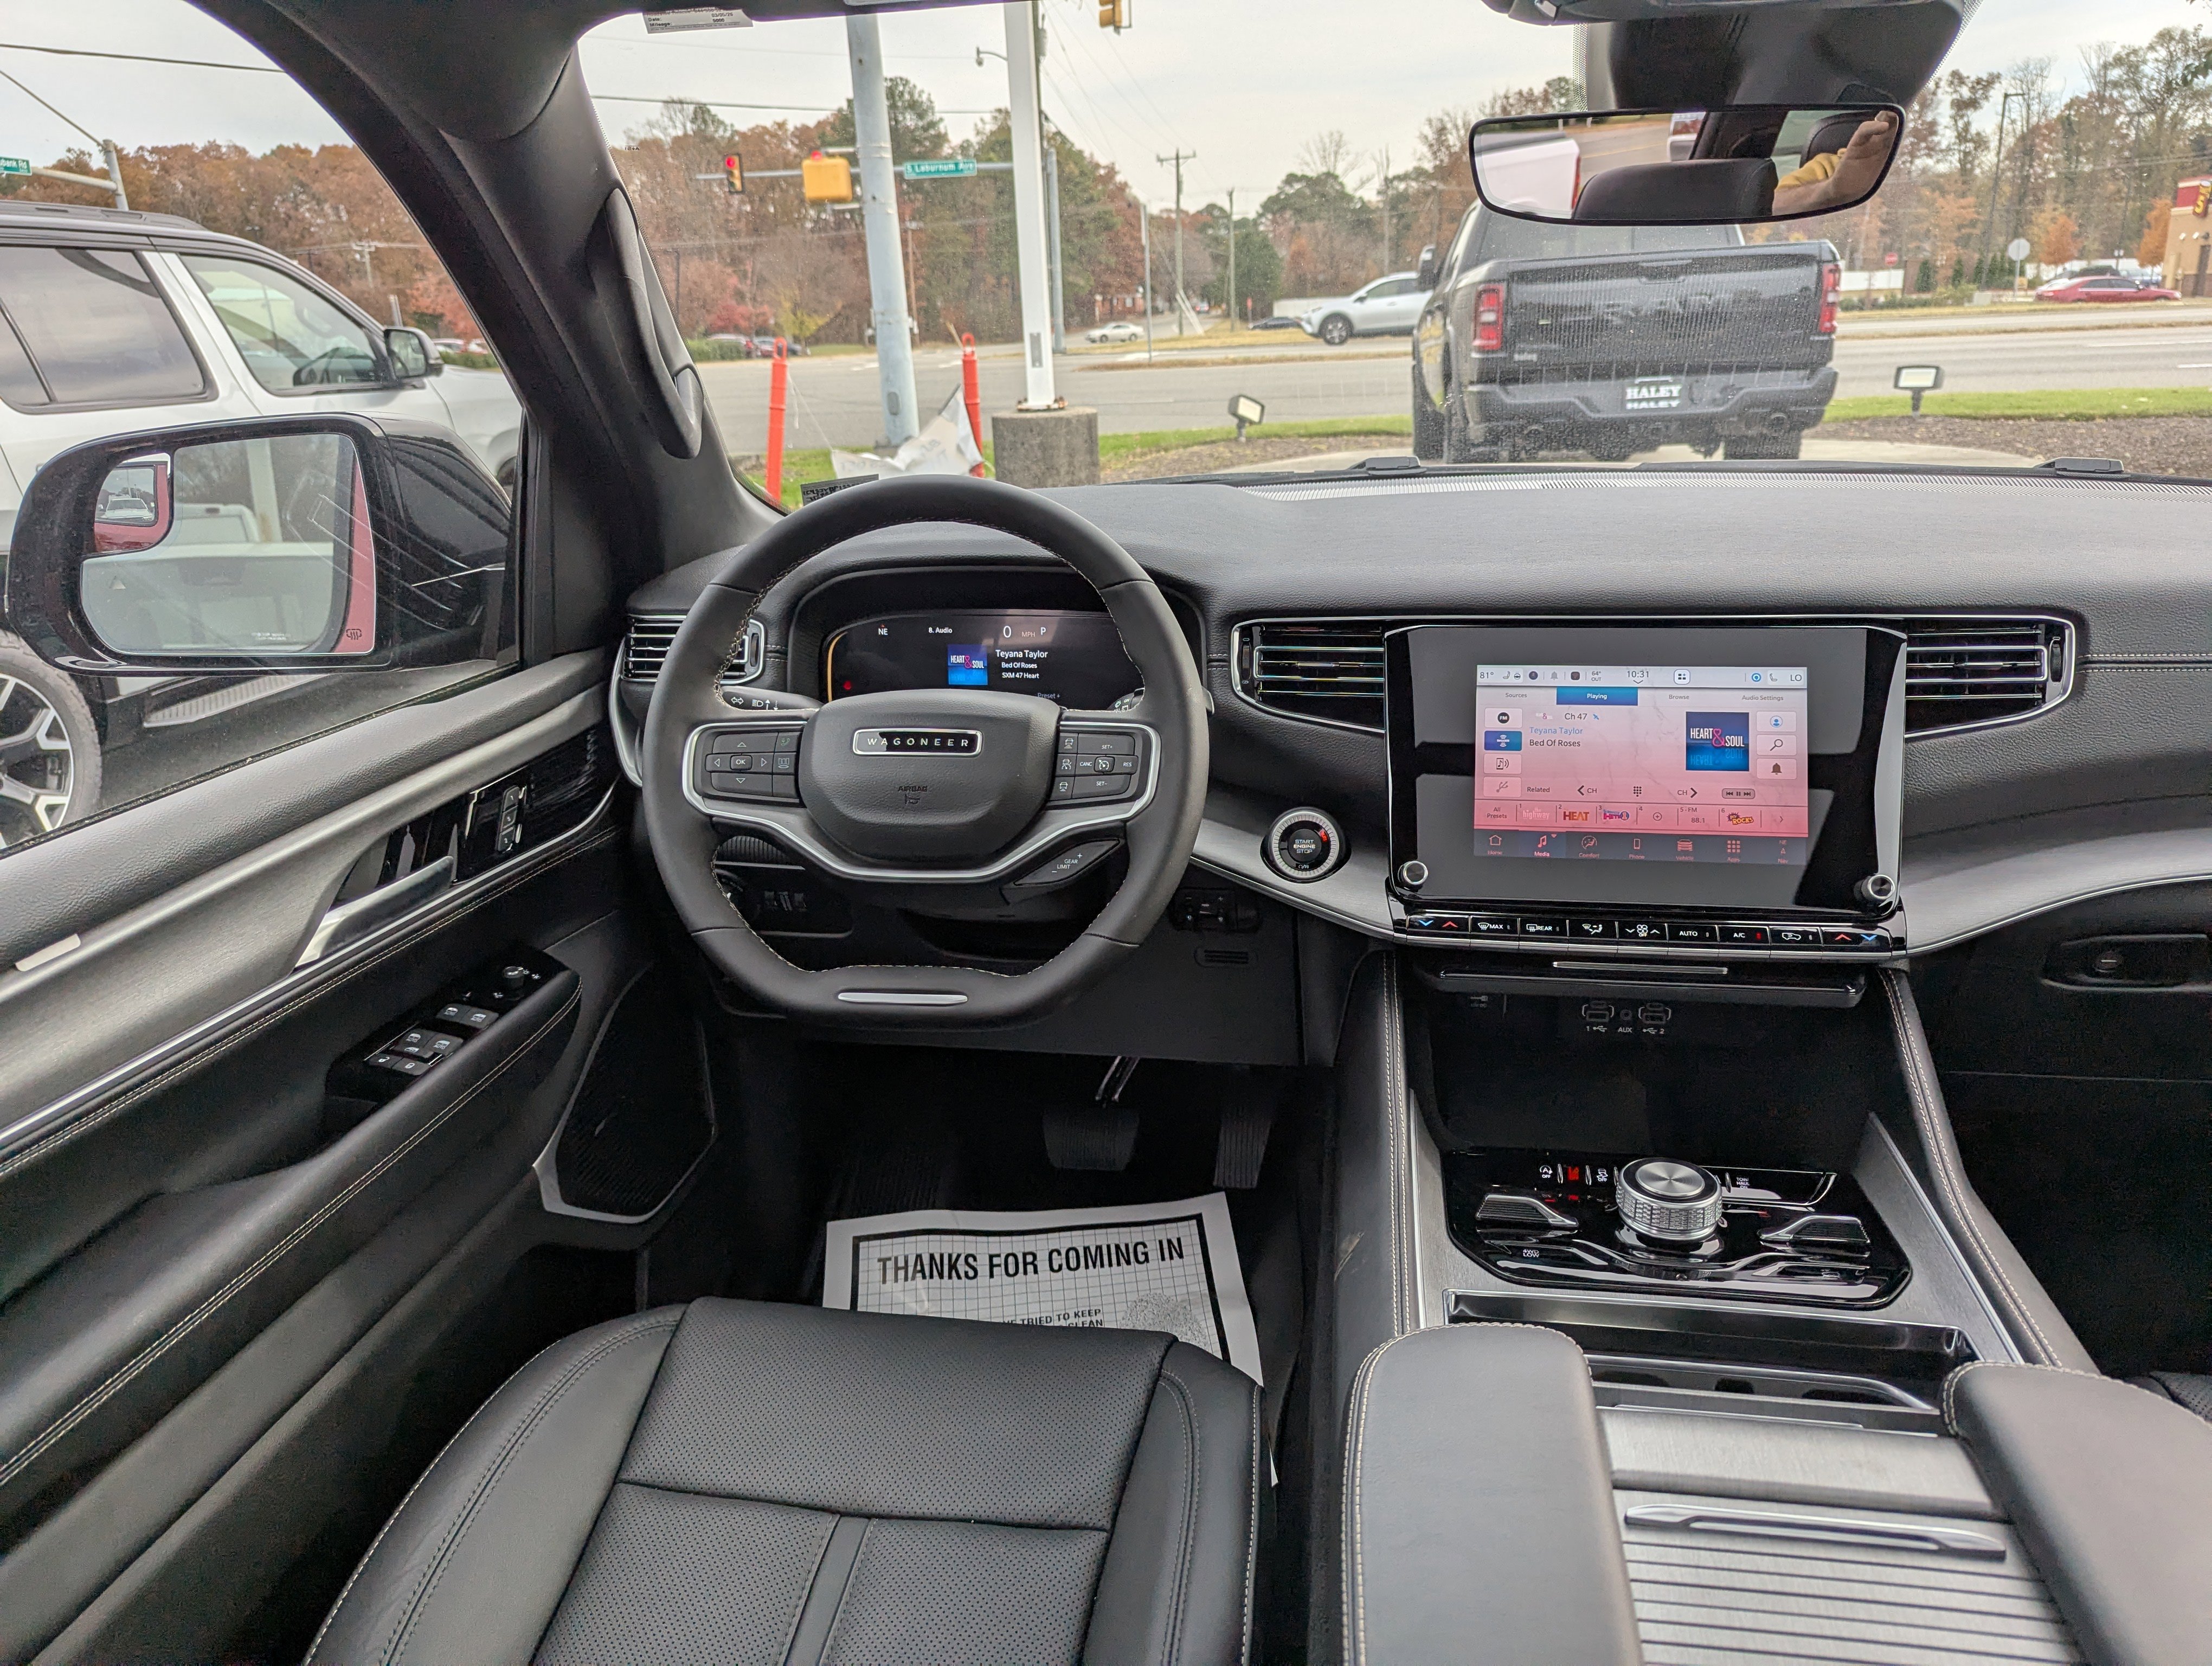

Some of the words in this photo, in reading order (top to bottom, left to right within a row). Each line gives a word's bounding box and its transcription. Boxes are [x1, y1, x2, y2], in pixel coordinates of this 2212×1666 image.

[1626, 384, 1682, 400] HALEY
[1003, 626, 1012, 638] 0
[1040, 627, 1046, 635] P
[995, 650, 1023, 658] Teyana
[1024, 650, 1048, 658] Taylor
[972, 661, 985, 669] SOUL
[1627, 670, 1649, 678] 10:31
[1529, 727, 1557, 735] Teyana
[1690, 728, 1713, 739] HEART
[1712, 728, 1726, 747] &
[1725, 736, 1745, 747] SOUL
[867, 738, 969, 747] WAGONEER
[1522, 809, 1550, 821] highway
[1563, 811, 1590, 821] HEAT
[1732, 816, 1754, 825] ROCKS
[877, 1252, 978, 1285] THANKS
[988, 1252, 1038, 1279] FOR
[1047, 1241, 1149, 1274] COMING
[1158, 1236, 1185, 1262] IN
[1020, 1316, 1052, 1325] TRIED
[1056, 1312, 1070, 1322] TO
[1074, 1309, 1101, 1318] KEEP
